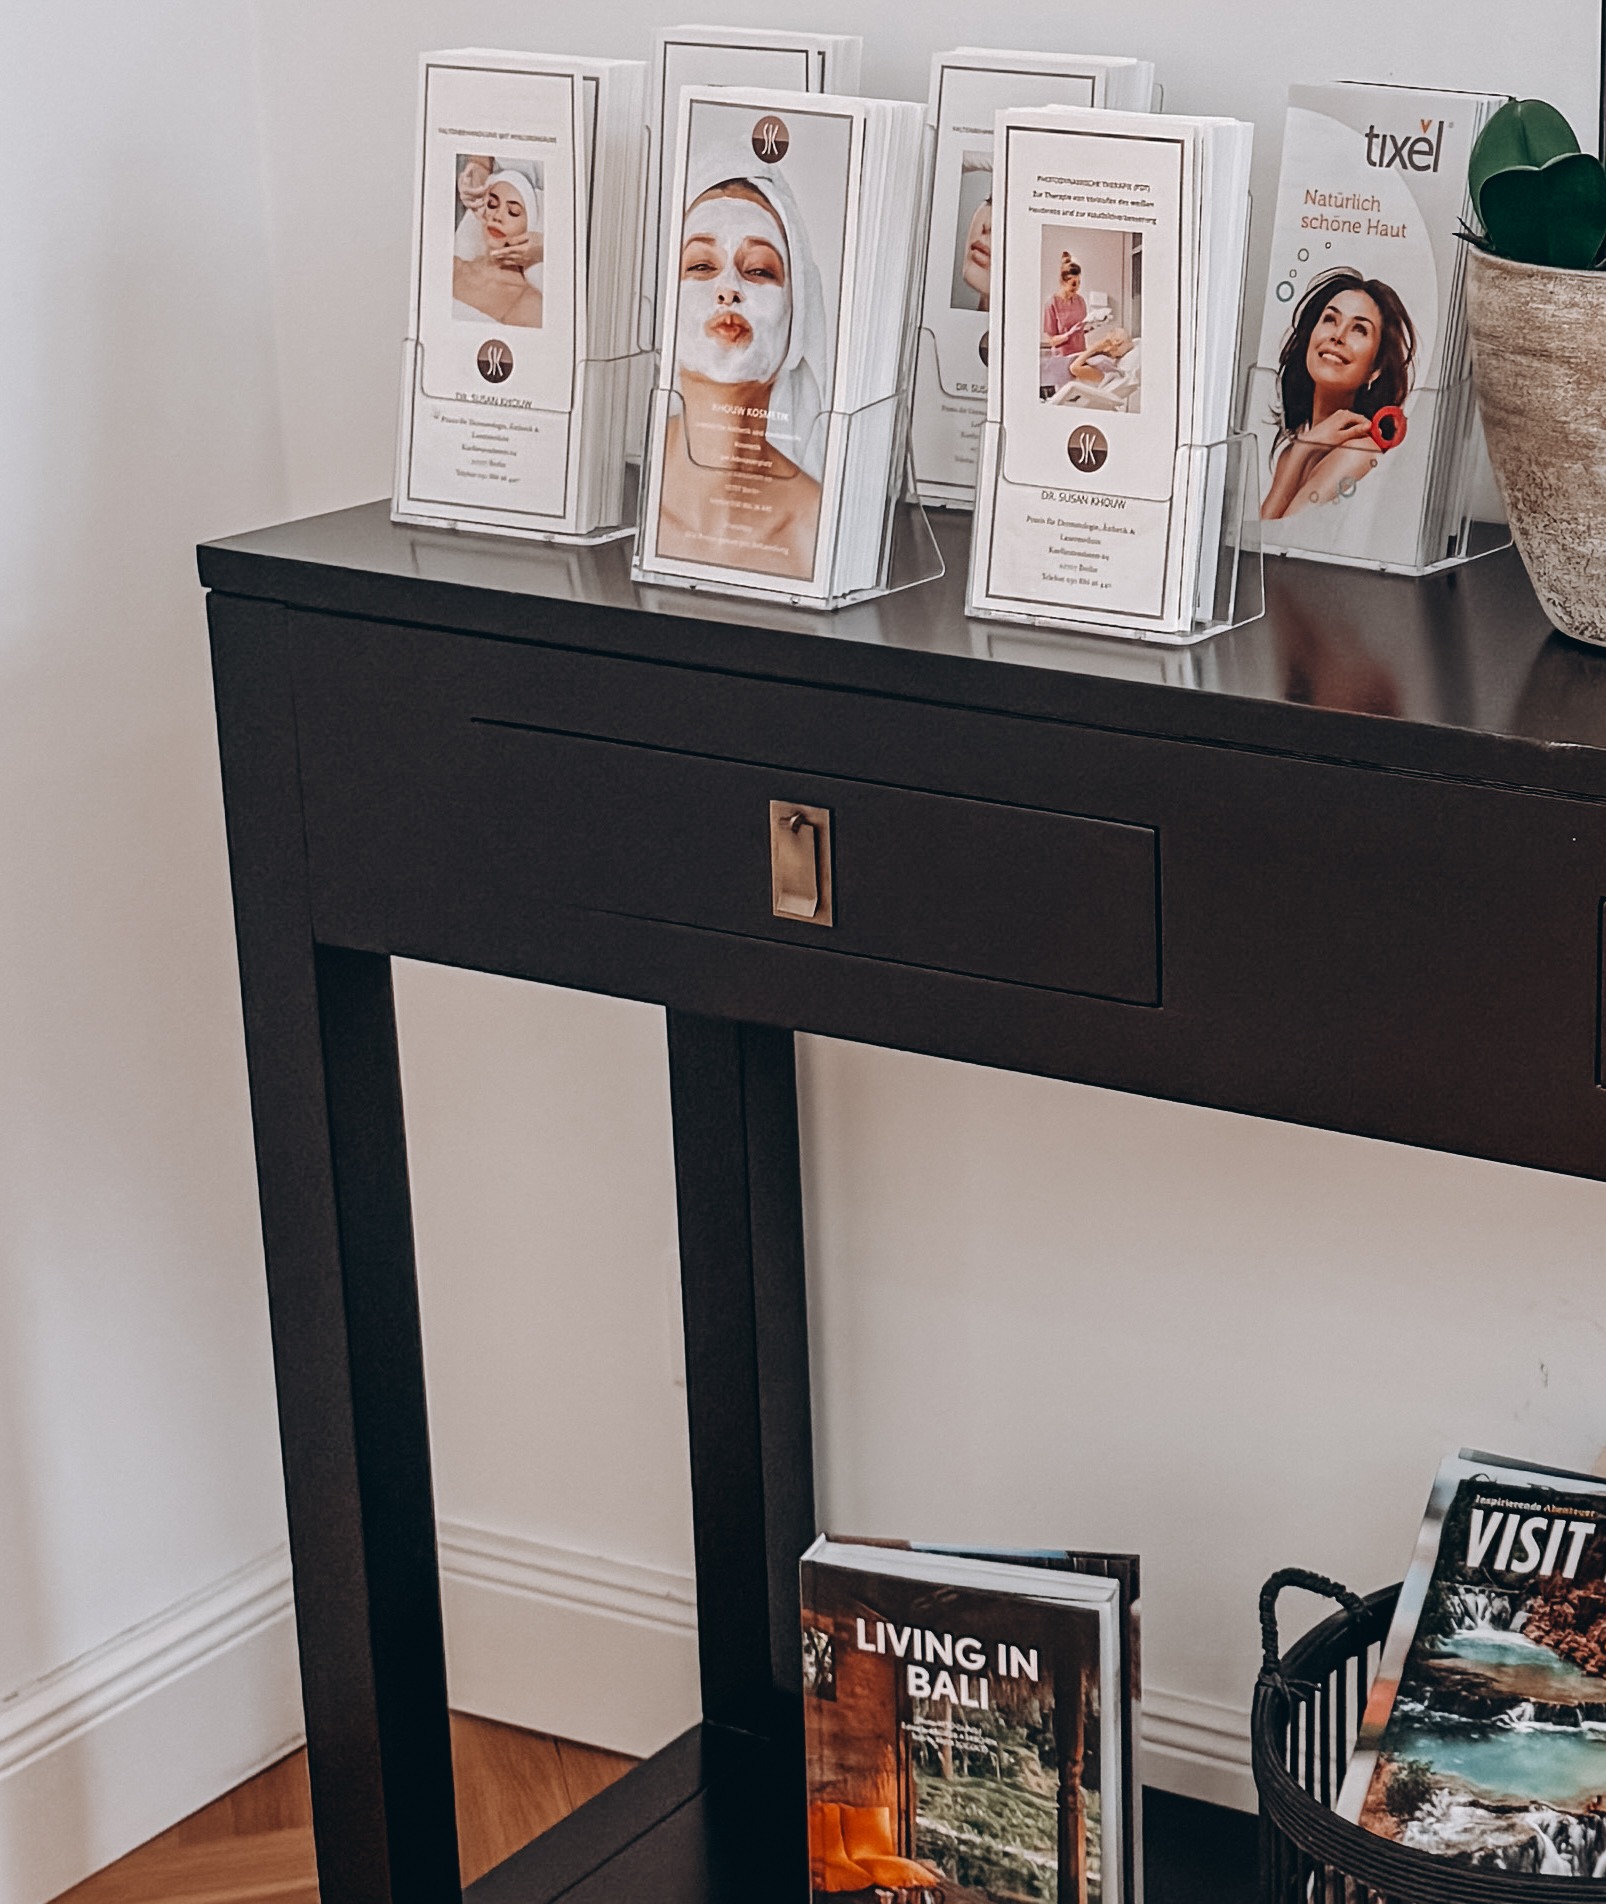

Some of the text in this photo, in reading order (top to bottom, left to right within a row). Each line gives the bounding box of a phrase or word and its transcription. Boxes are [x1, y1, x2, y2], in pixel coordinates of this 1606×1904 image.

[1365, 119, 1445, 173] tixel
[1303, 189, 1381, 213] Natürlich
[1301, 214, 1408, 239] schöne Haut
[1040, 490, 1127, 510] DR. SUSAN KHOUW
[1475, 1494, 1596, 1517] Inspirierende Abenteuer
[1466, 1508, 1597, 1580] VISIT
[856, 1617, 1039, 1682] LIVING IN
[907, 1663, 989, 1711] BALI
